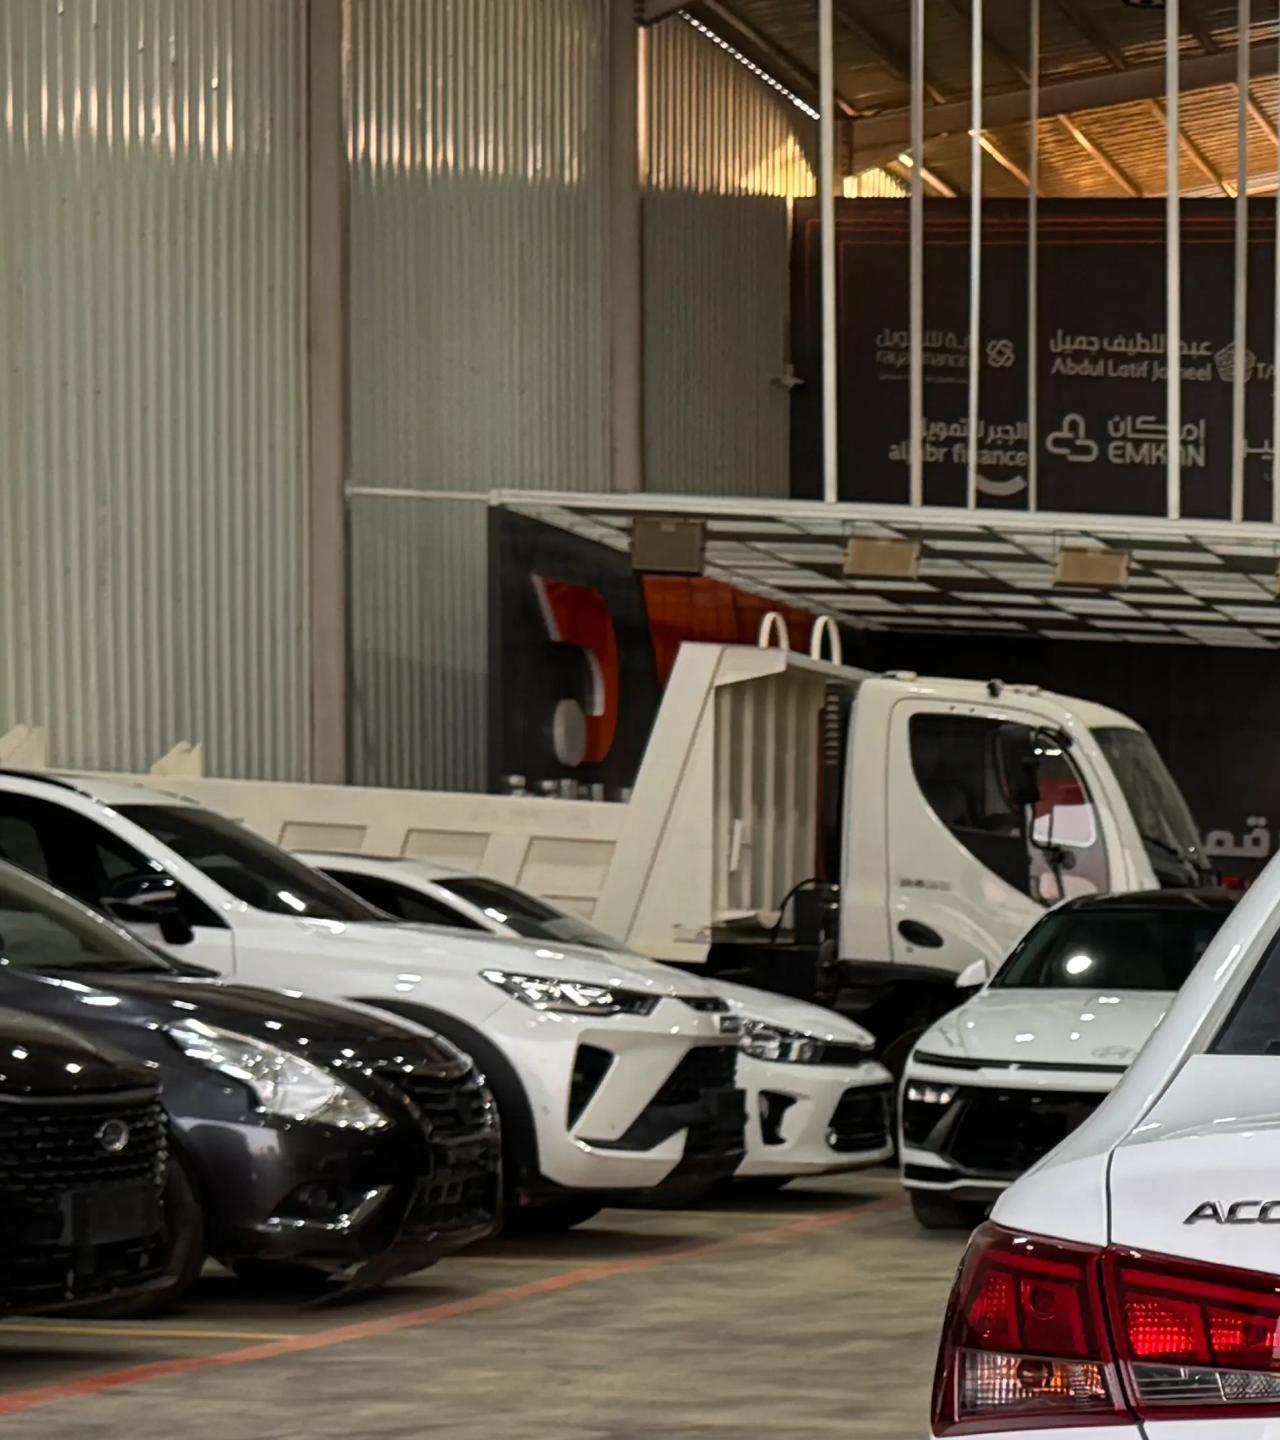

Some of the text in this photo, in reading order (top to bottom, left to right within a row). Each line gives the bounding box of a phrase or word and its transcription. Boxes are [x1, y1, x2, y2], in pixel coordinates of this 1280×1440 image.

[1050, 327, 1101, 356] جميل
[1051, 356, 1105, 377] Abdul
[1151, 361, 1212, 382] Jaeel
